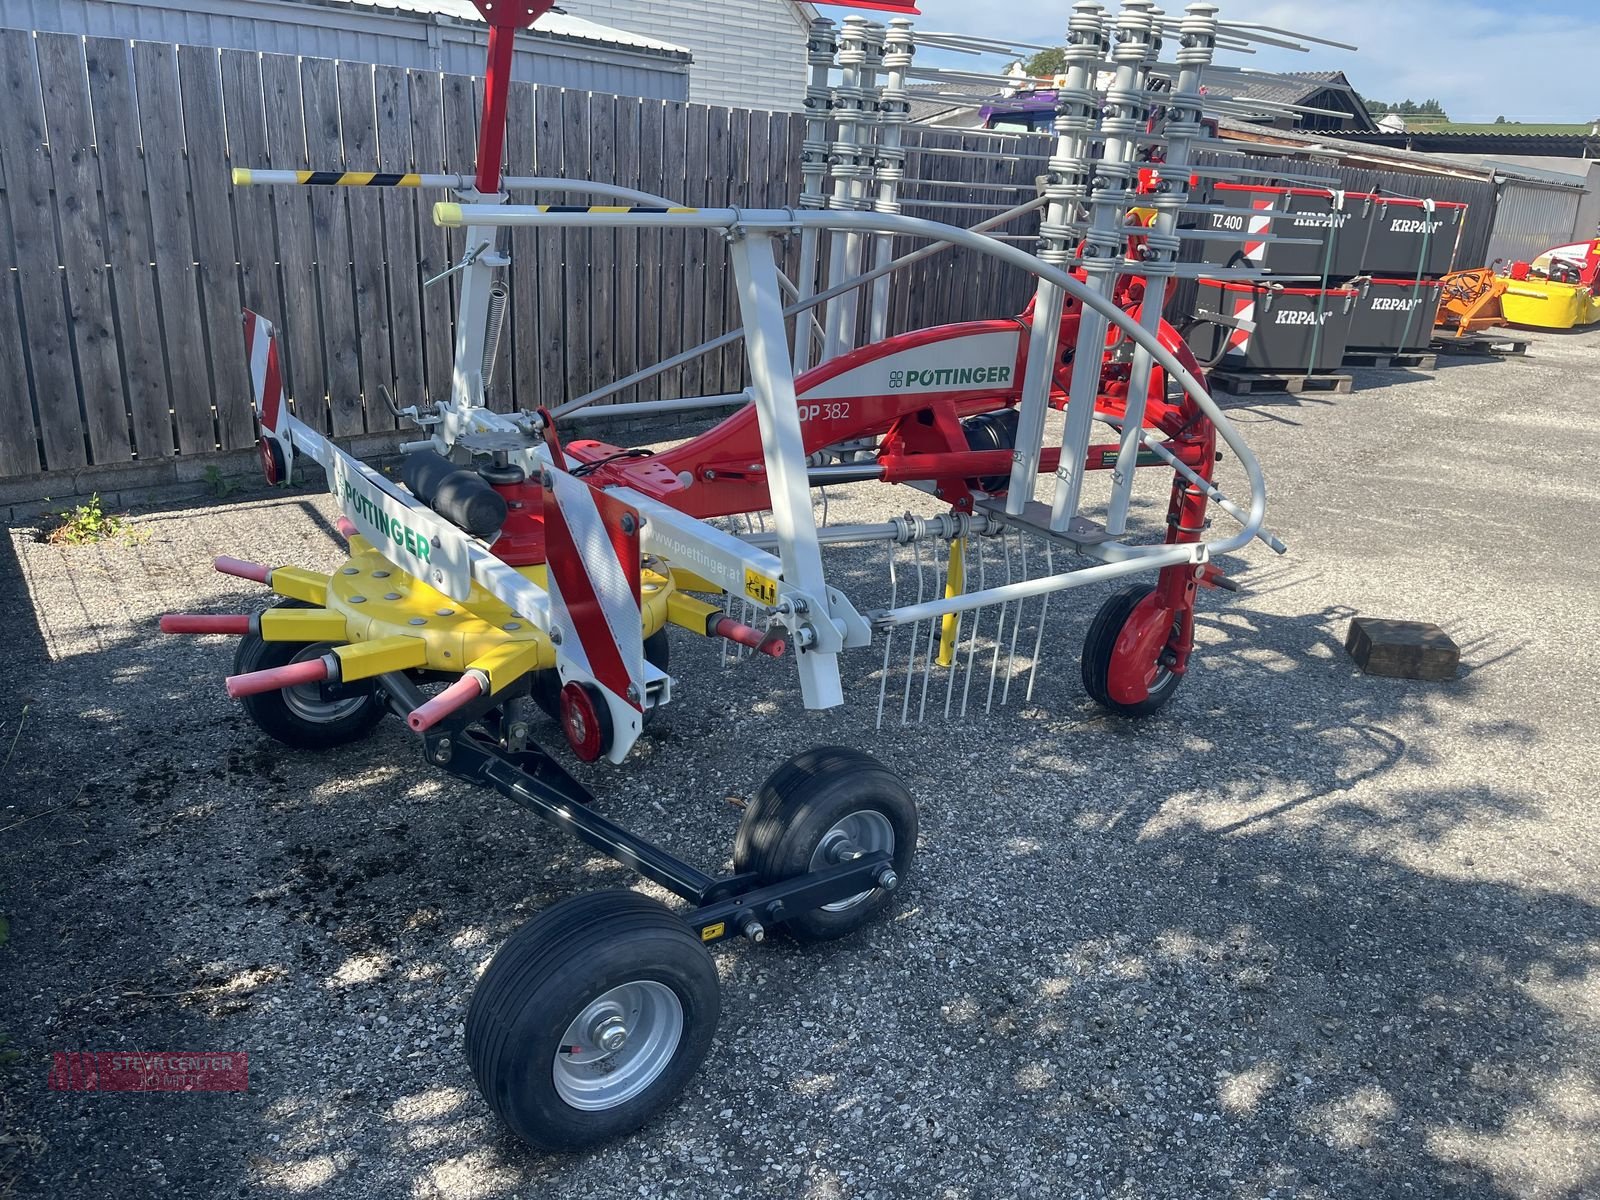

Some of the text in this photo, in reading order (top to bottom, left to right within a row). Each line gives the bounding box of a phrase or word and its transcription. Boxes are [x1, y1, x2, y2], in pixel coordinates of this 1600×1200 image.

[1213, 213, 1243, 230] TZ 400
[1390, 219, 1438, 234] KRPAN
[1371, 298, 1417, 311] KRPAN
[1275, 310, 1327, 325] KRPAN
[906, 366, 1010, 387] PÖTTINGER
[797, 402, 850, 422] OP 382
[646, 527, 741, 584] www.poettinger.at
